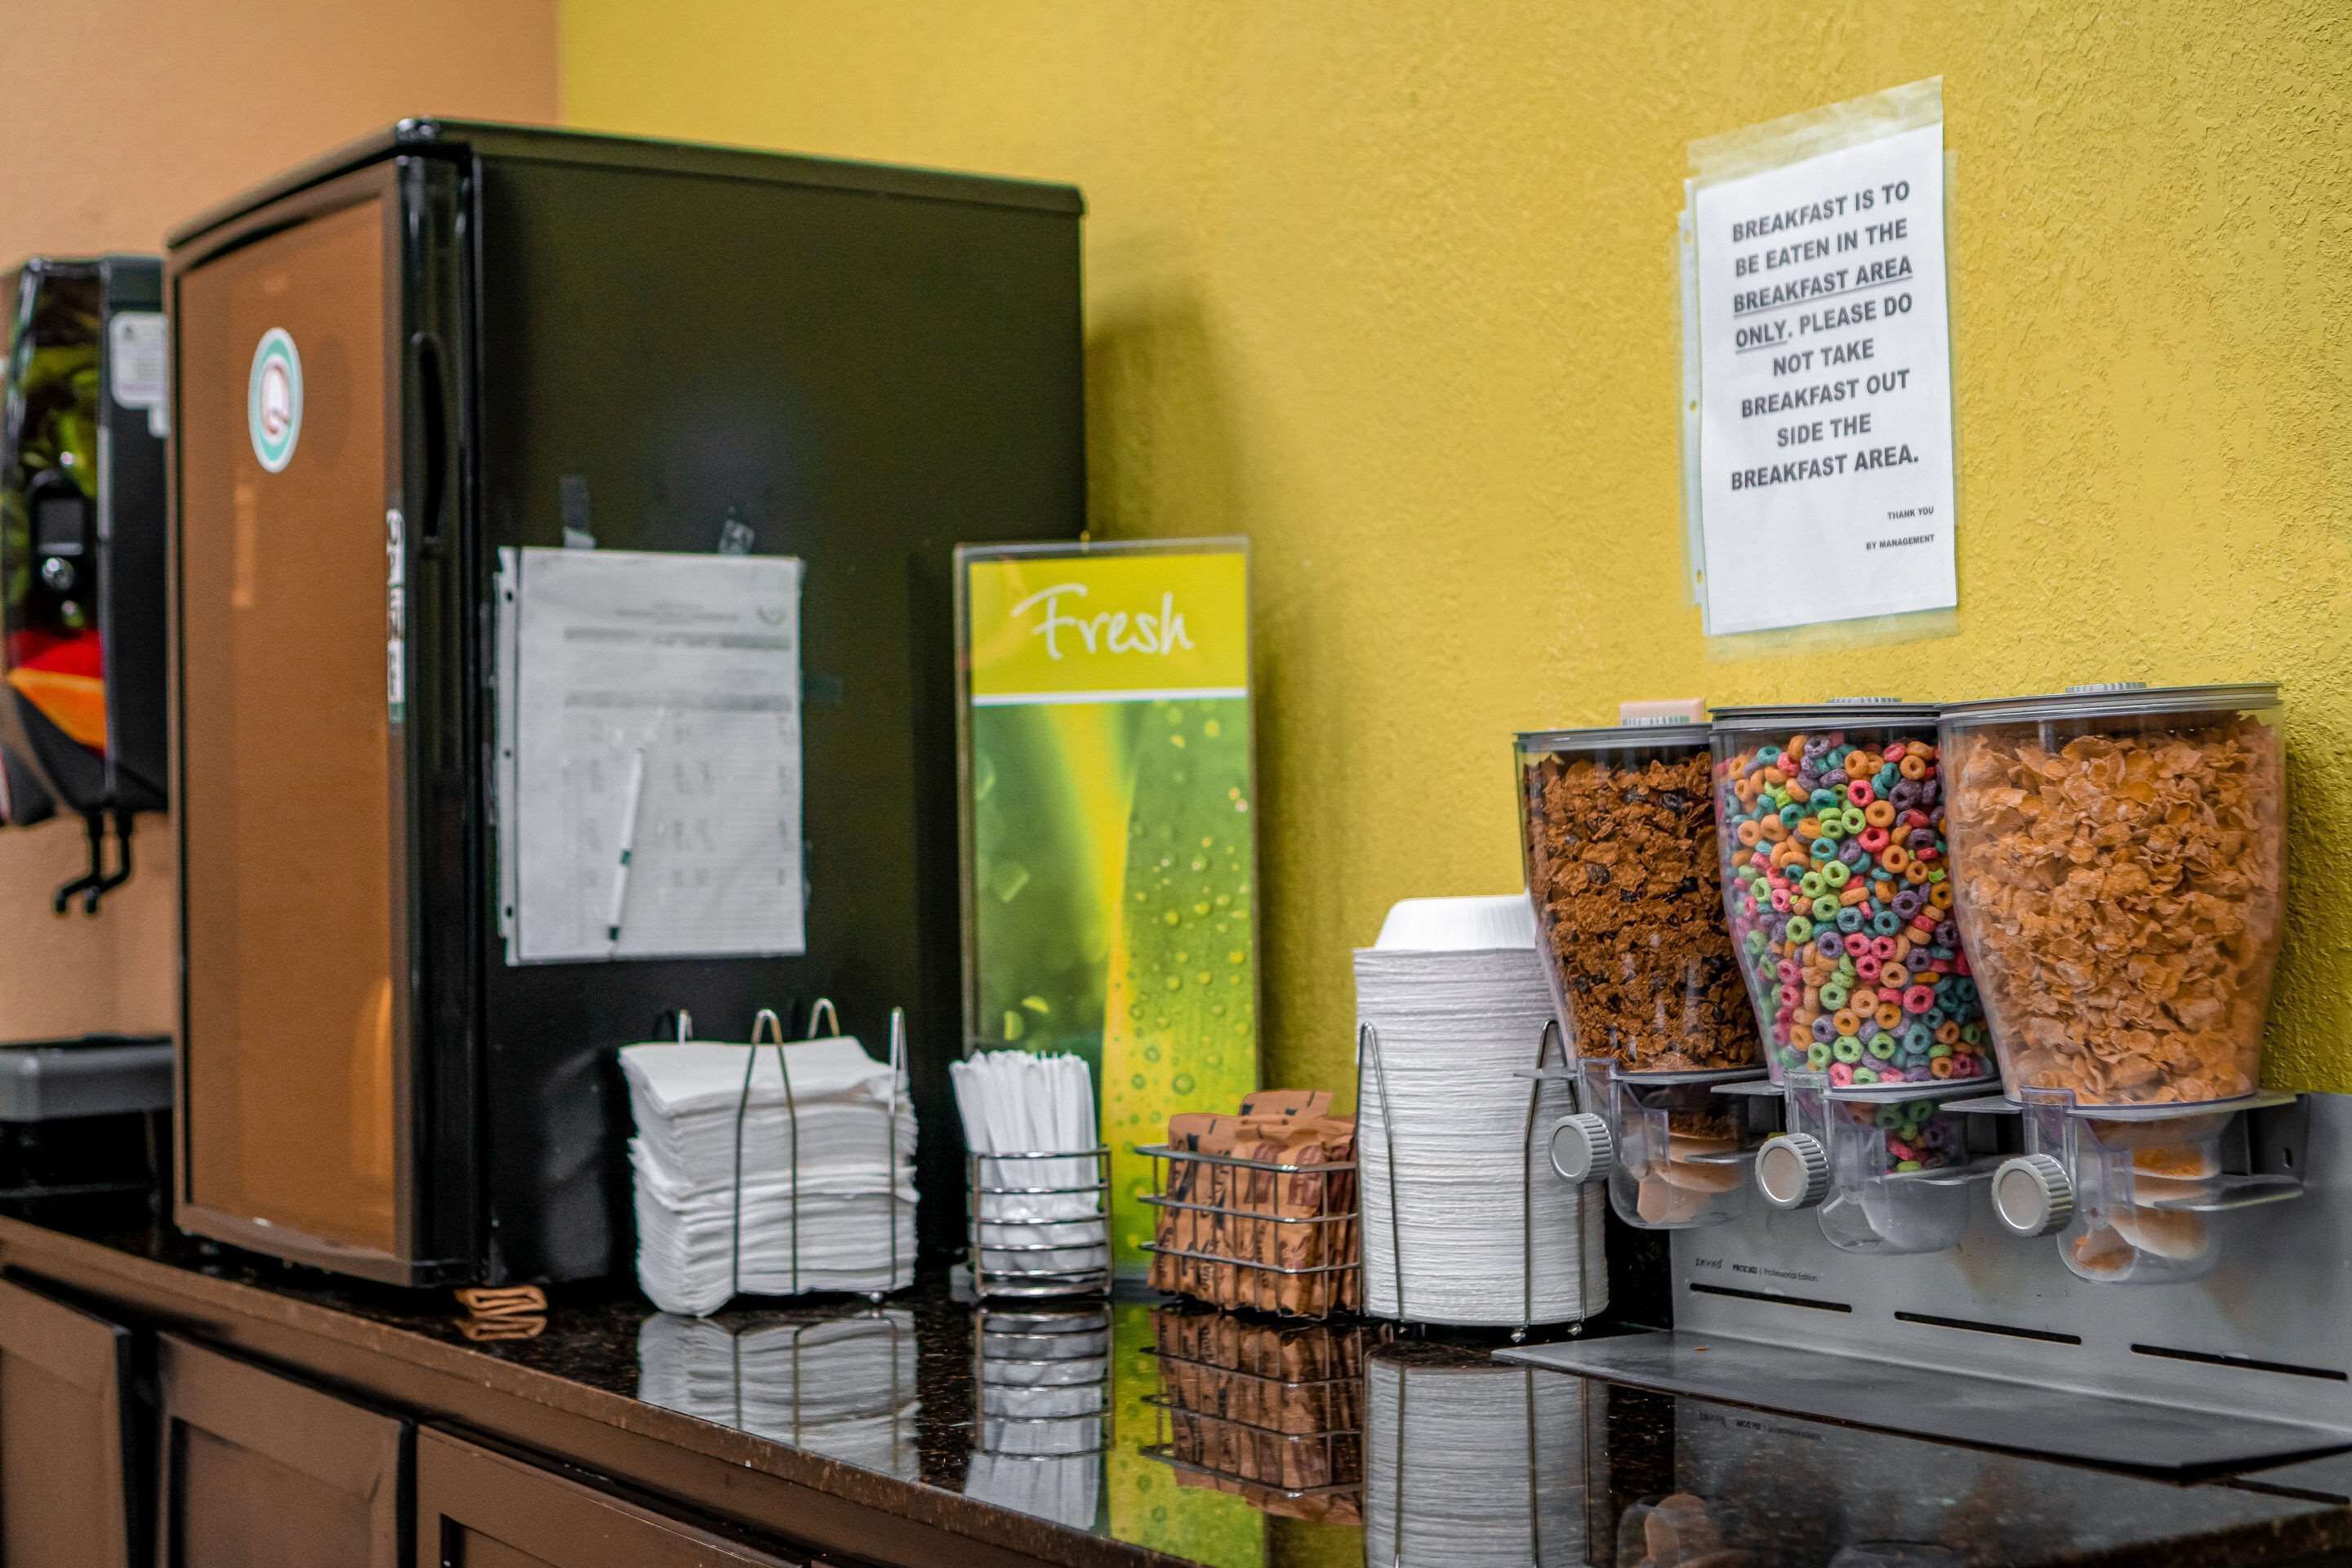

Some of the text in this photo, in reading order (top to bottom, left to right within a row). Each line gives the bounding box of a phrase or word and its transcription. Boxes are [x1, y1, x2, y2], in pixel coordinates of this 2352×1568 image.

[1732, 180, 1910, 243] BREAKFAST IS TO
[1735, 217, 1908, 278] BE EATEN IN THE
[1733, 255, 1913, 314] BREAKFAST AREA
[1735, 292, 1913, 348] ONLY. PLEASE DO
[1772, 338, 1874, 377] NOT TAKE
[1741, 368, 1910, 419] BREAKFAST OUT
[1776, 412, 1871, 448] SIDE THE
[1731, 444, 1918, 492] BREAKFAST AREA.
[1886, 506, 1934, 519] THANK YOU
[1865, 534, 1935, 550] BY MANAGEMENT
[1009, 583, 1194, 660] Fresh
